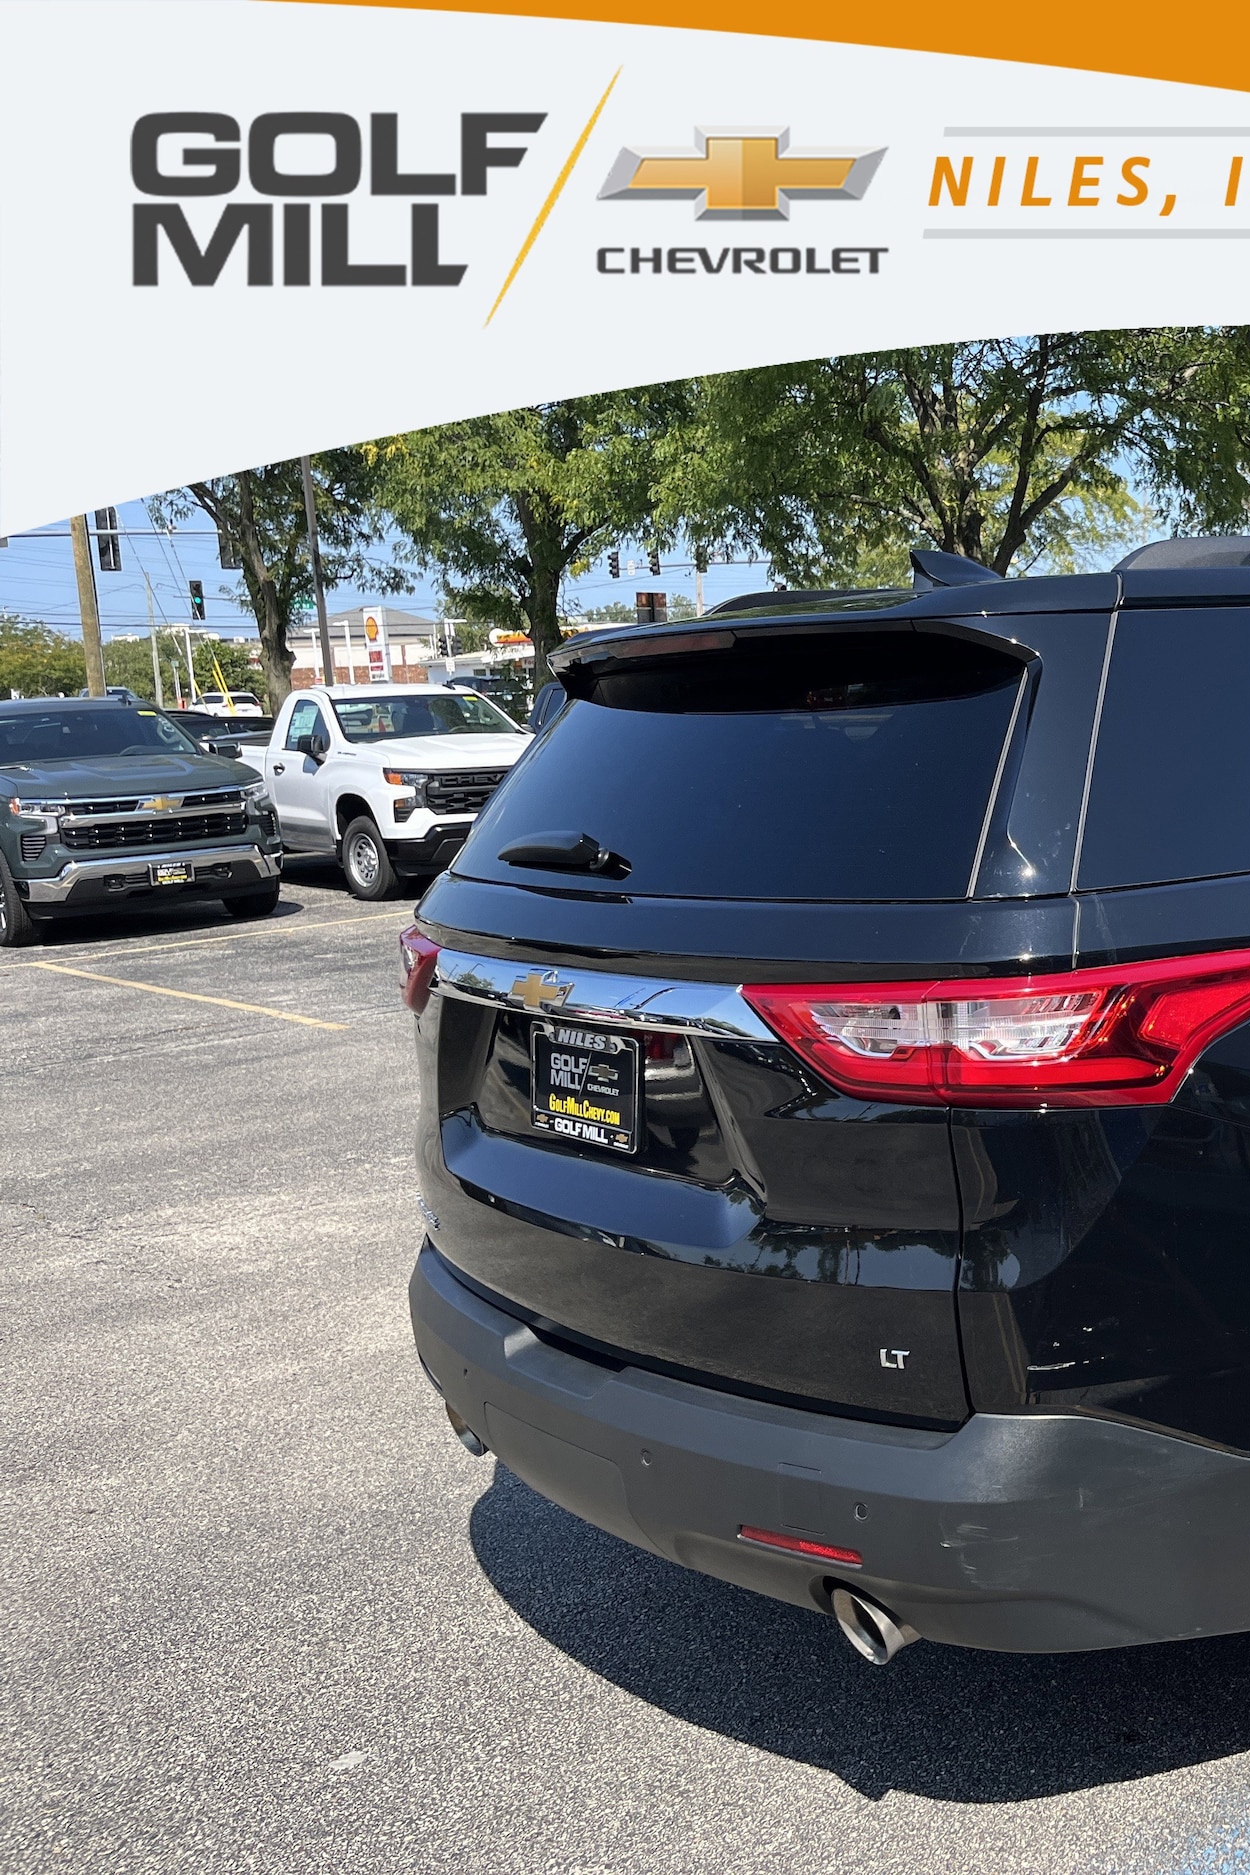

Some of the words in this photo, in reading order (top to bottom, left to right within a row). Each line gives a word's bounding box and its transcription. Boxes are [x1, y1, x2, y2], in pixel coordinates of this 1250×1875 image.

[558, 1029, 606, 1050] NILES
[550, 1052, 588, 1074] GOLF
[550, 1068, 580, 1090] MILL
[587, 1083, 620, 1096] CHEVROLET
[554, 1118, 582, 1136] GOLF
[582, 1124, 608, 1144] MILL
[880, 1348, 910, 1369] LT
